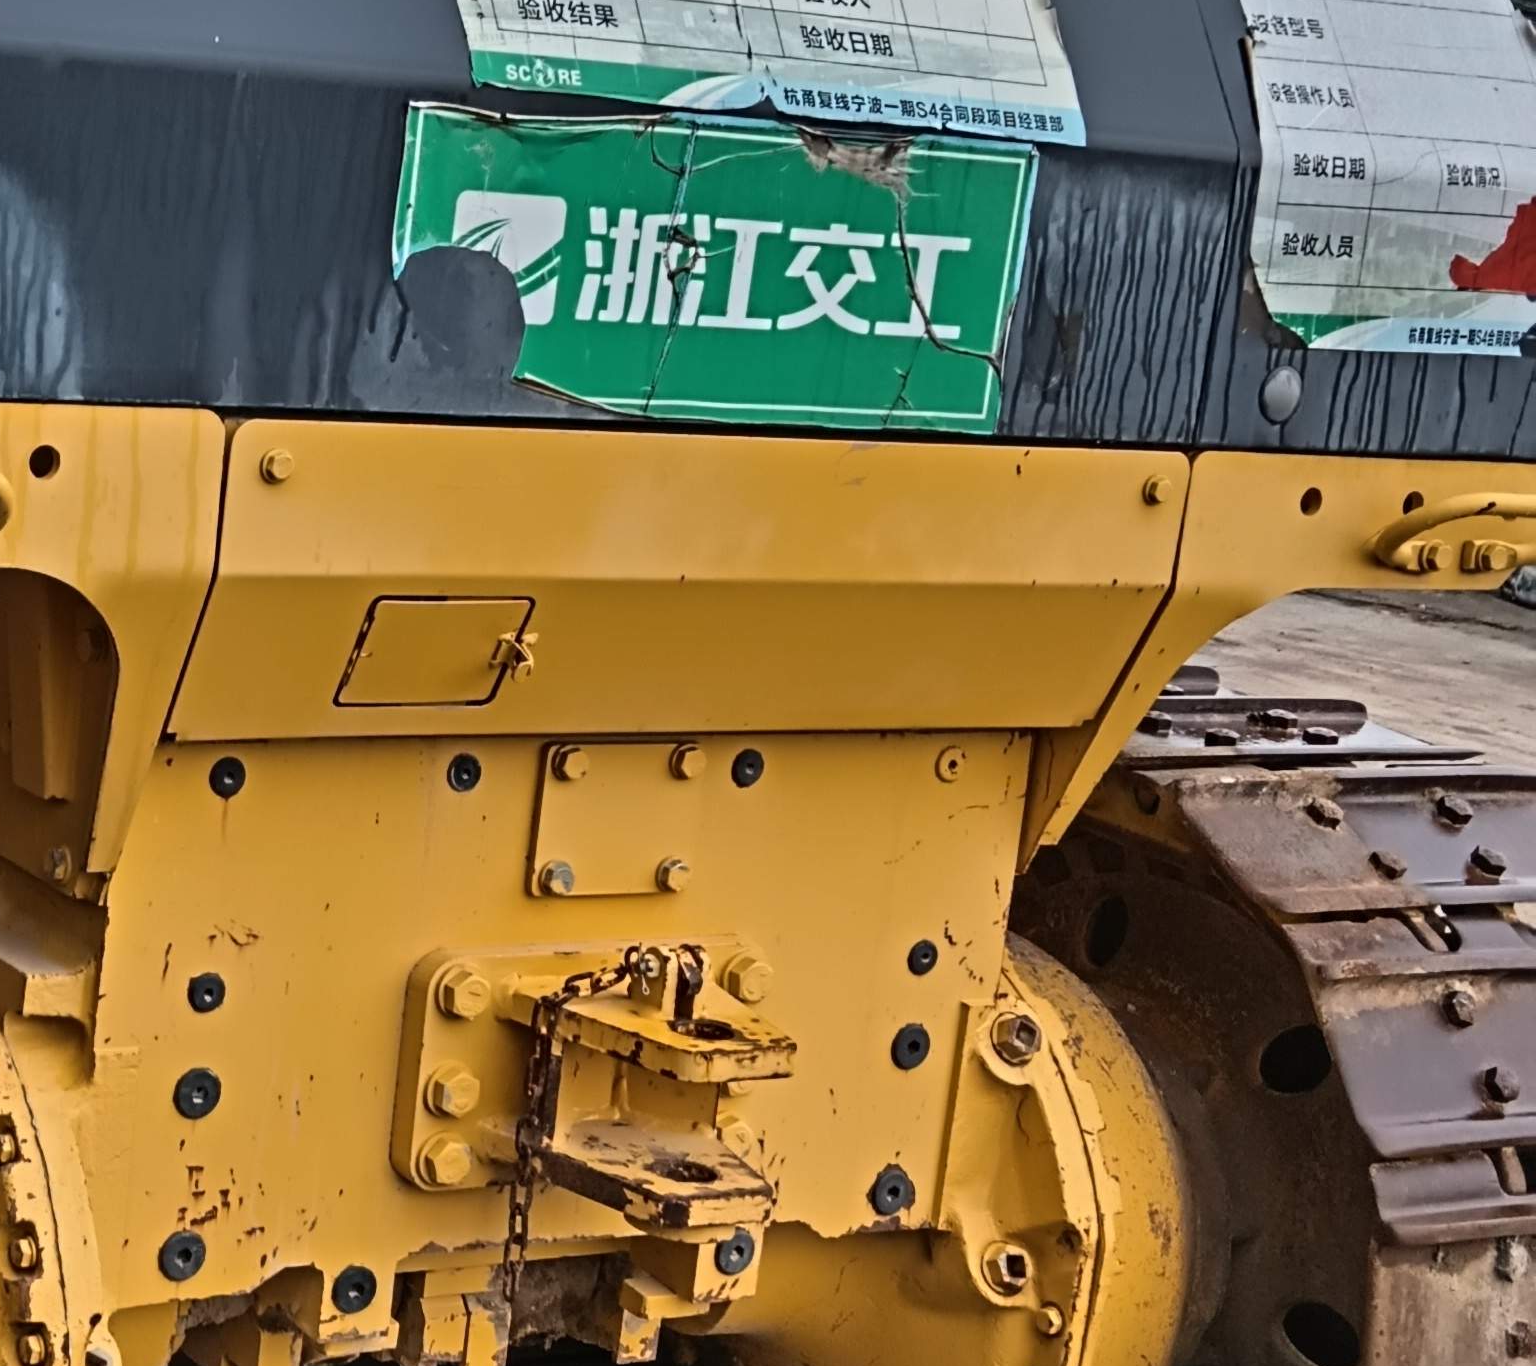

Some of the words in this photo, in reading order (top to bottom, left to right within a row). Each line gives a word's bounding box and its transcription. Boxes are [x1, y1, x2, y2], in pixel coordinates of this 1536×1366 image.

[1250, 13, 1324, 39] 设备型号
[801, 26, 894, 57] 验收日期
[1267, 82, 1355, 108] 设备操作人员
[783, 88, 1064, 133] 杭甬复线宁波一期S4合同段项目经理部
[1293, 153, 1366, 180] 验收日期
[1446, 163, 1501, 189] 验收情况
[1282, 231, 1355, 259] 验收人员
[575, 205, 972, 340] 浙江交工
